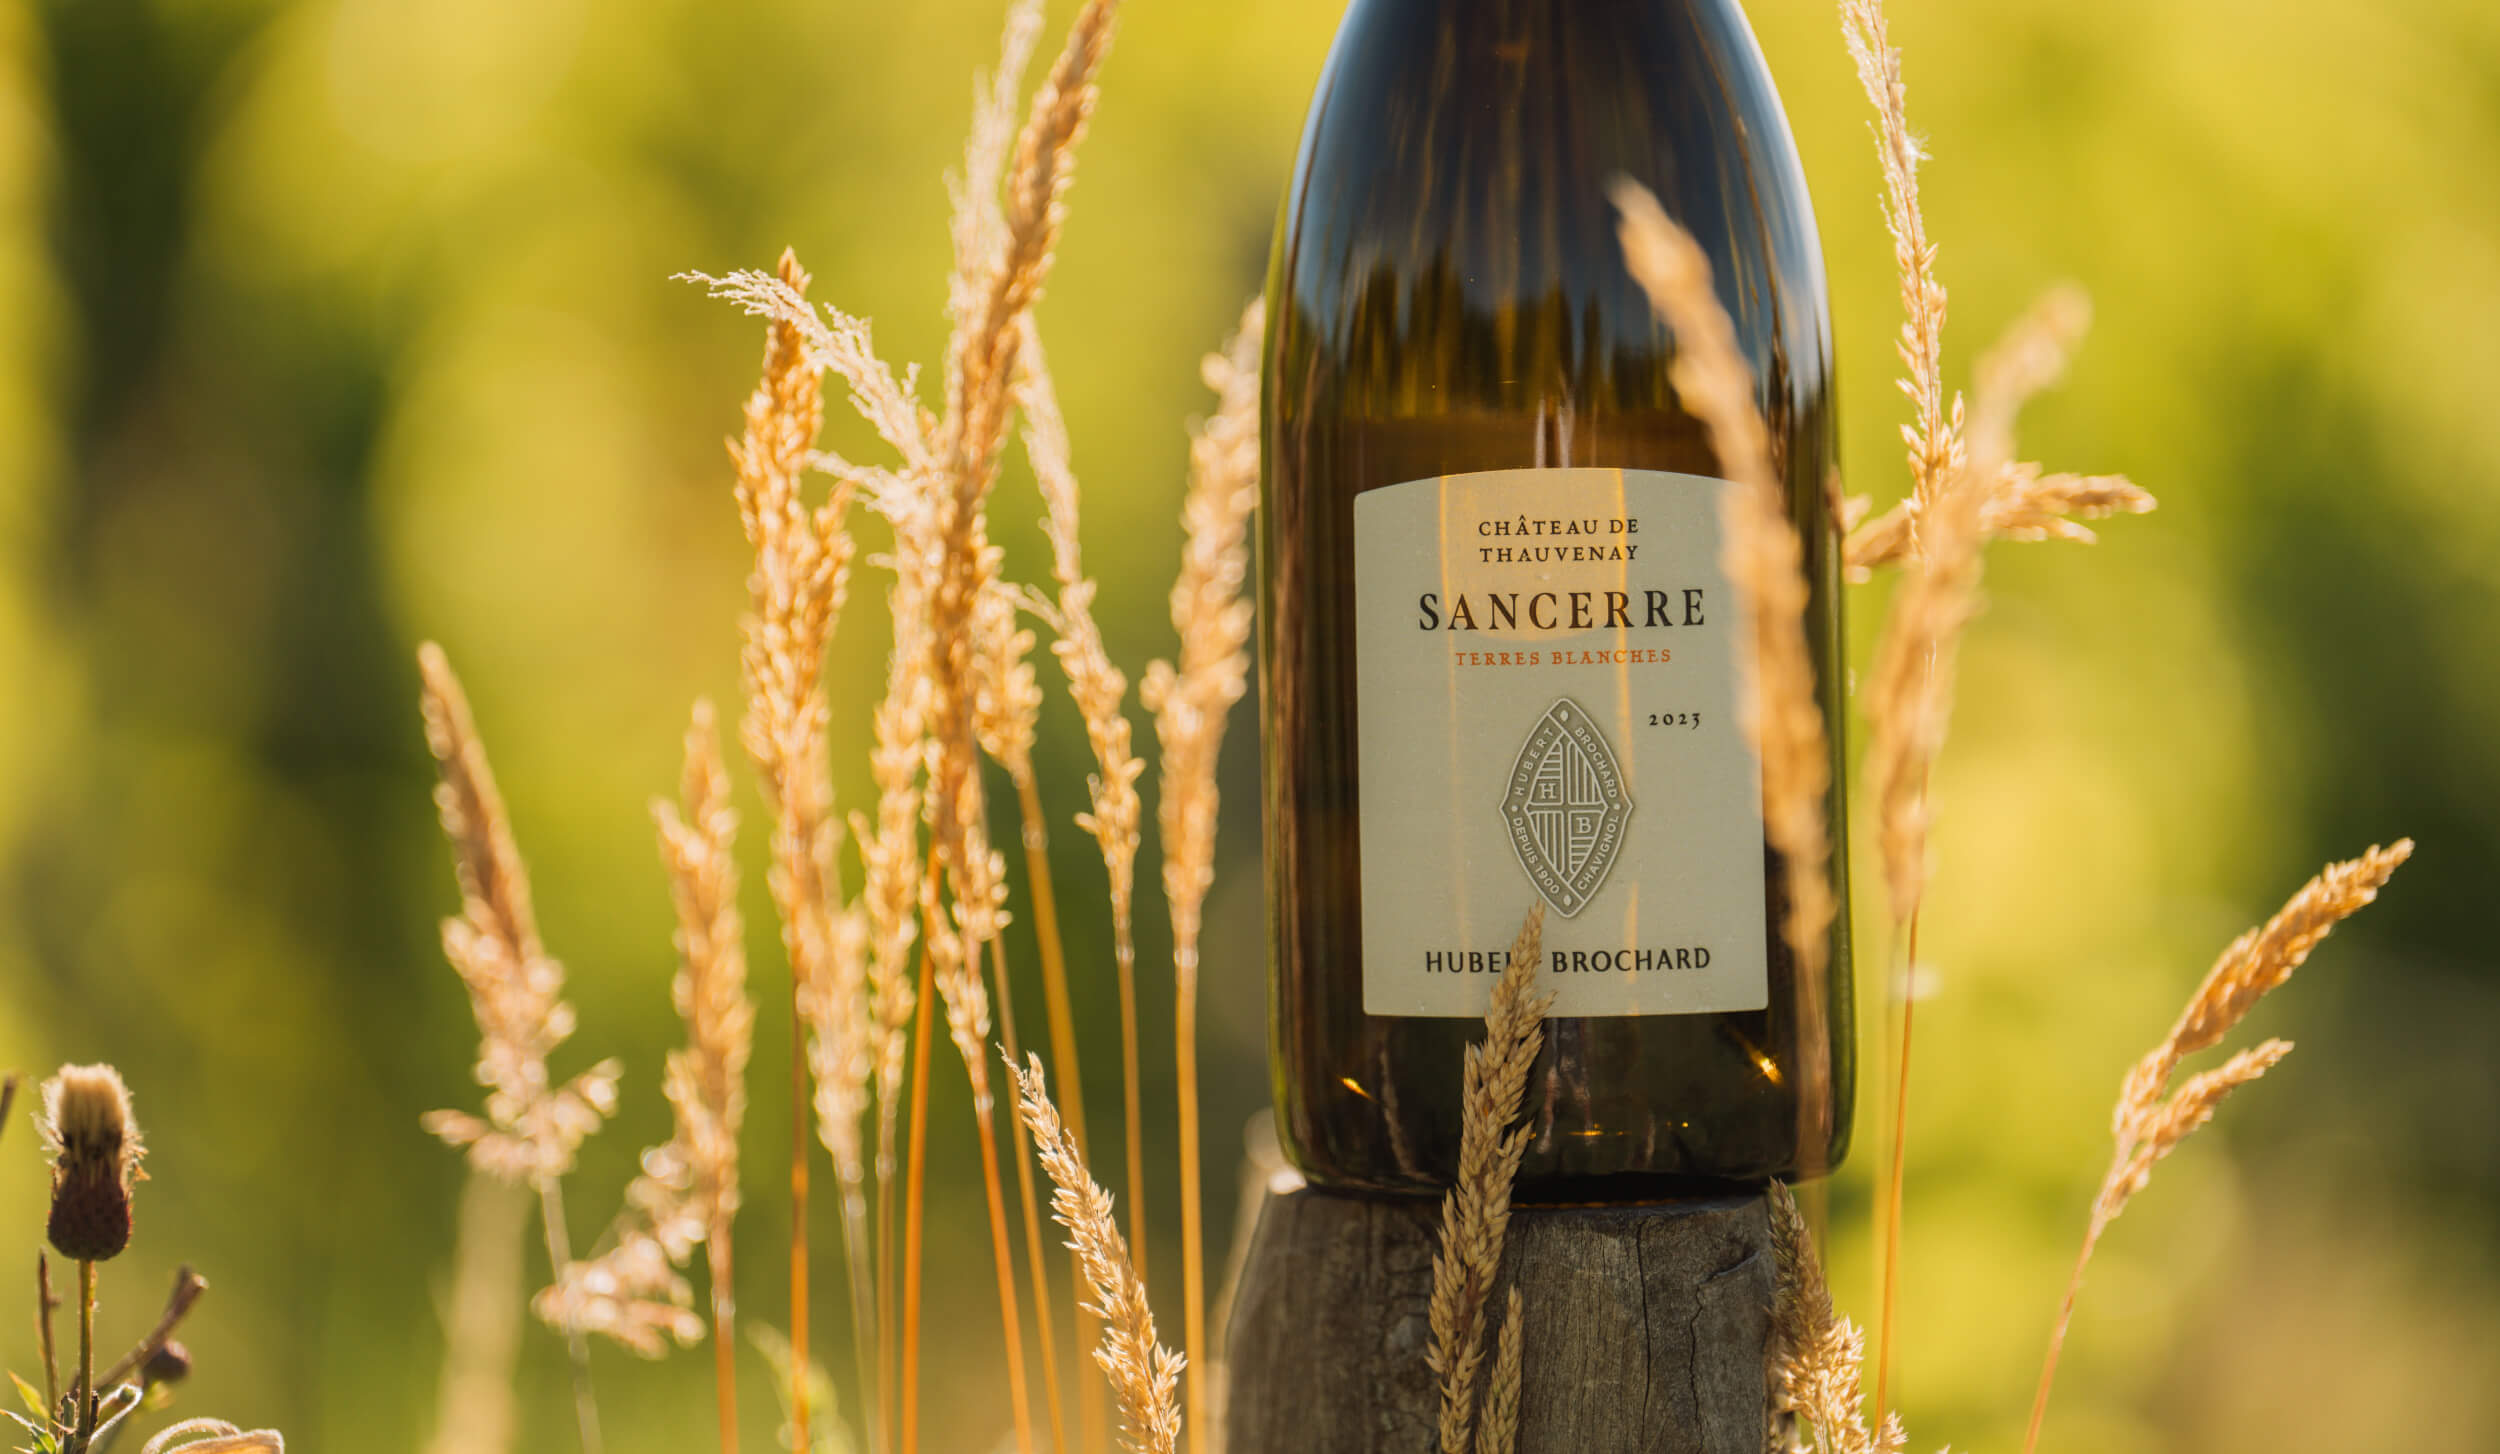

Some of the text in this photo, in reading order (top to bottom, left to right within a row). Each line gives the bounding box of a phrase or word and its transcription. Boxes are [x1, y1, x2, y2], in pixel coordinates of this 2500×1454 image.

[1478, 514, 1639, 536] CHÂTEAU DE
[1479, 545, 1639, 563] THAUVENAY
[1419, 588, 1705, 631] SANCERRE
[1455, 649, 1671, 666] TERRES BLANCHES
[1649, 712, 1701, 730] 2023
[1514, 727, 1553, 797] HUBERT
[1574, 727, 1617, 799] BROCHARD
[1538, 783, 1557, 800] H
[1575, 816, 1592, 834] B
[1513, 817, 1560, 896] DEPUIS 1900
[1576, 815, 1620, 891] CHAVIGNOL
[1425, 947, 1711, 973] HUBE BROCHARD
